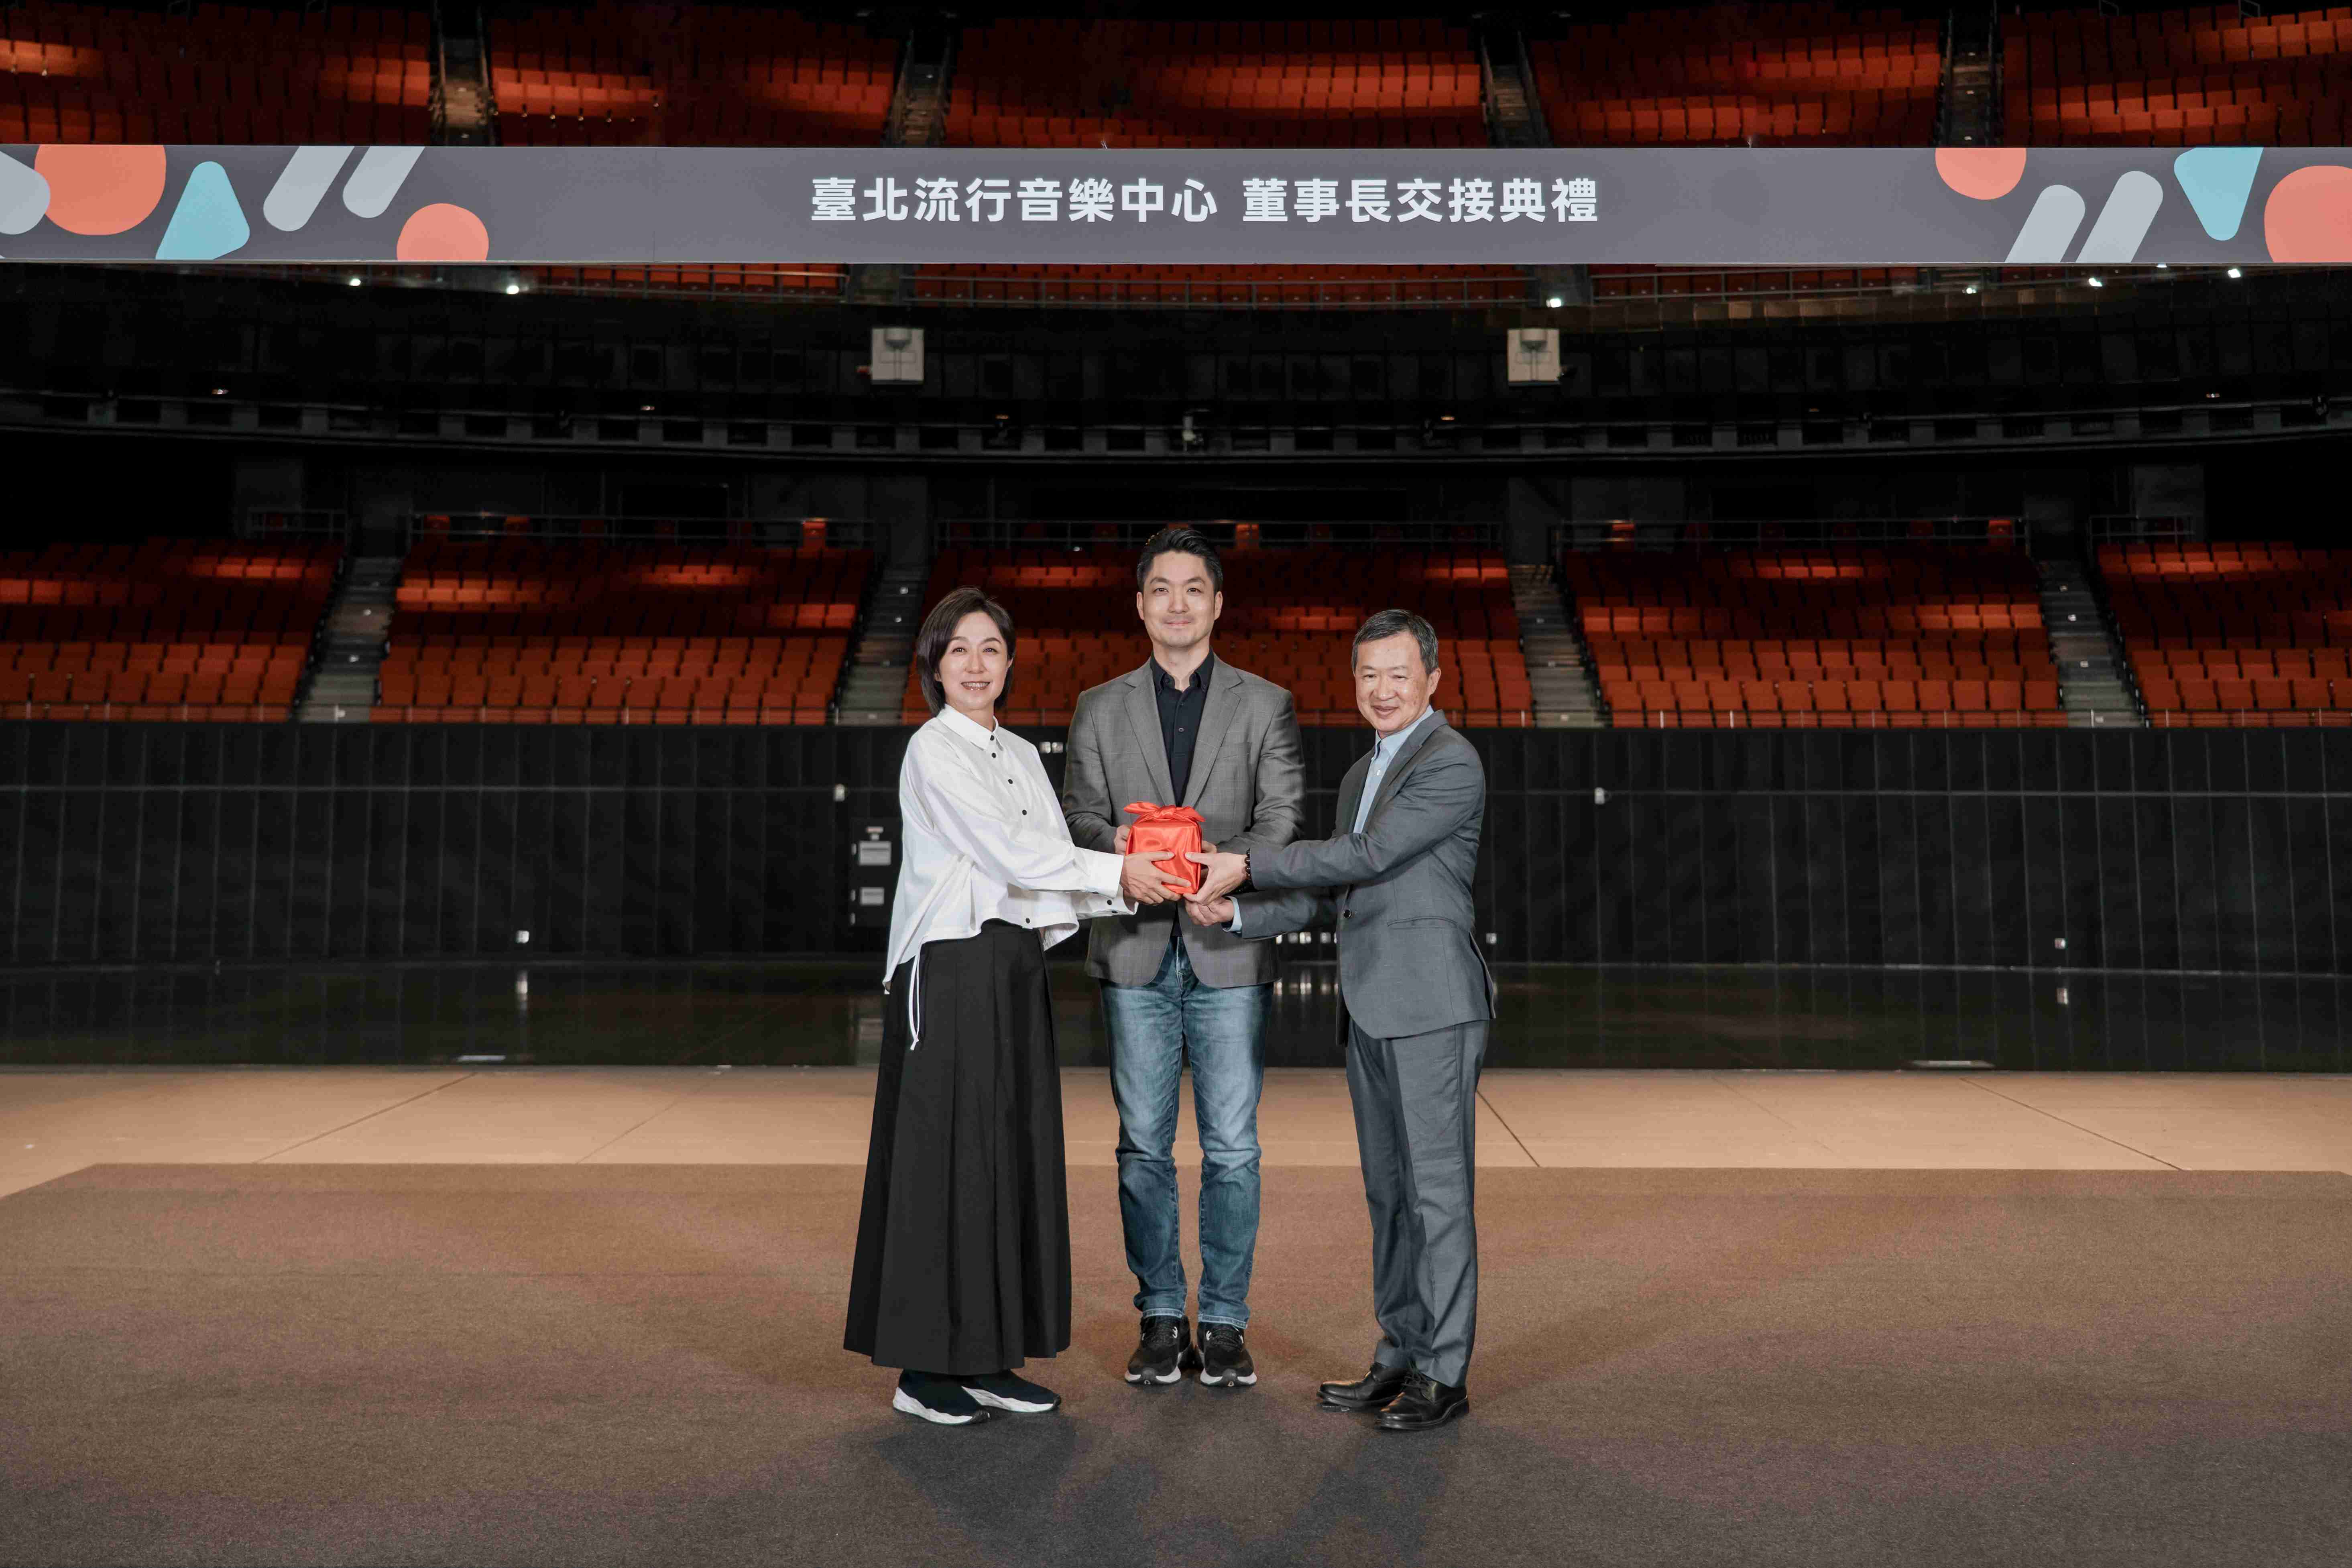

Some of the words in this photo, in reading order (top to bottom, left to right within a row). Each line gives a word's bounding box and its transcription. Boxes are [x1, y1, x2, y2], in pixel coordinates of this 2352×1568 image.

[811, 177, 1217, 222] 臺北流行音樂中心
[1243, 178, 1597, 222] 董事長交接典禮
